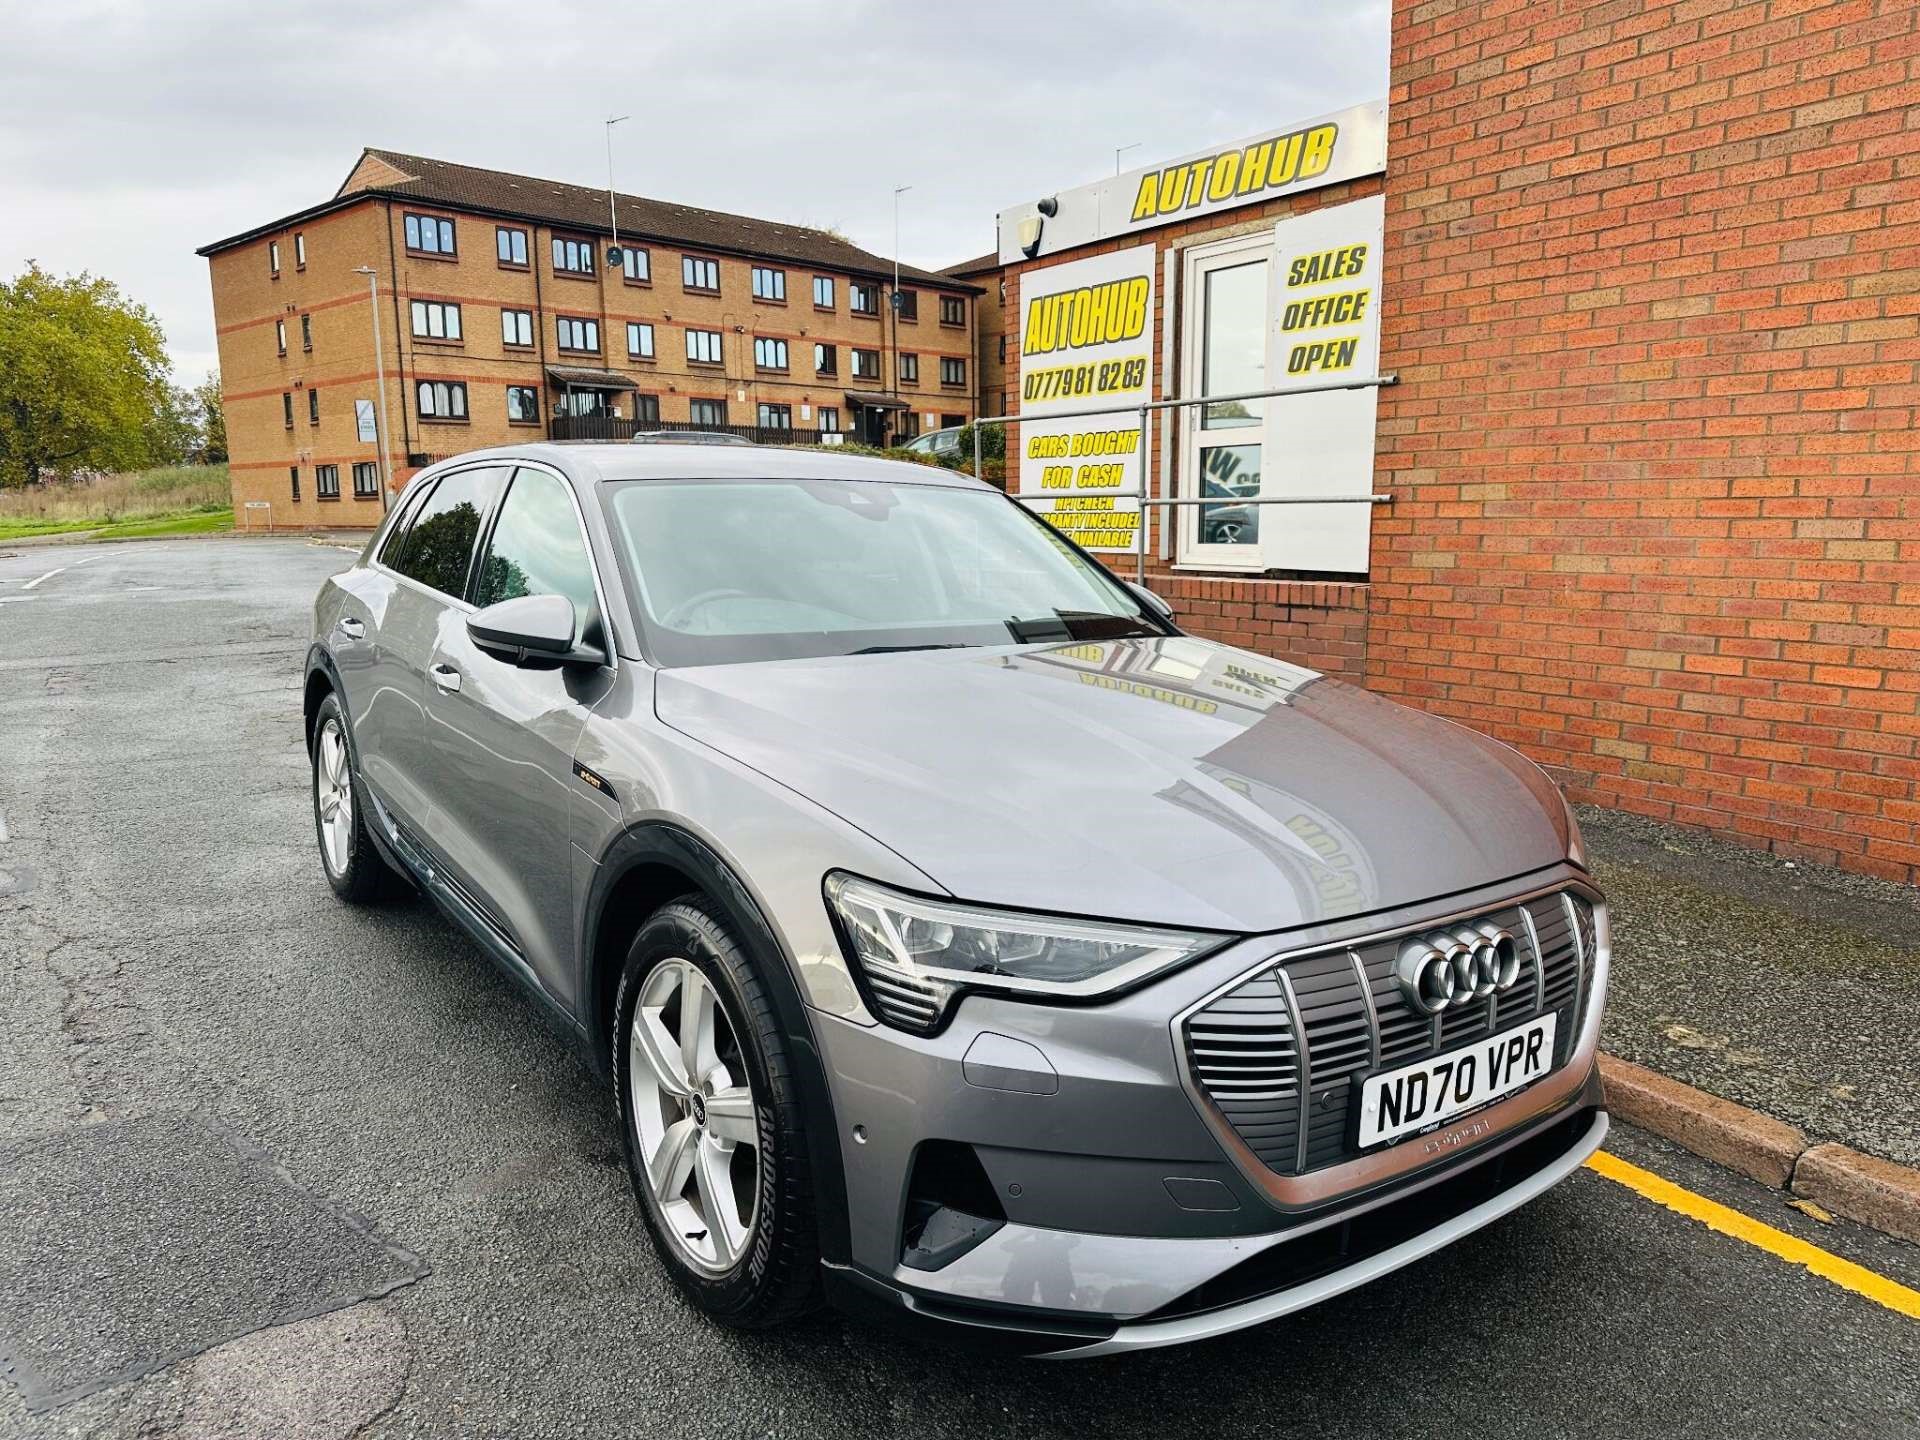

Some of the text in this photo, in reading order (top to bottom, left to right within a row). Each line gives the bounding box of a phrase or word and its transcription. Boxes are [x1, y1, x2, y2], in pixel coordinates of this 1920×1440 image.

[1131, 122, 1339, 222] AUTOHUB
[1287, 245, 1368, 287] SALES
[1023, 275, 1150, 357] AUTOHUB
[1281, 290, 1369, 331] OFFICE
[1287, 338, 1359, 373] OPEN
[1027, 429, 1140, 459] CARS BOUGHT
[1041, 462, 1124, 488] FOR CASH
[1075, 496, 1115, 511] CHECK
[1377, 1026, 1544, 1133] ND70 VPR
[749, 1103, 777, 1287] BRIDGESTONE
